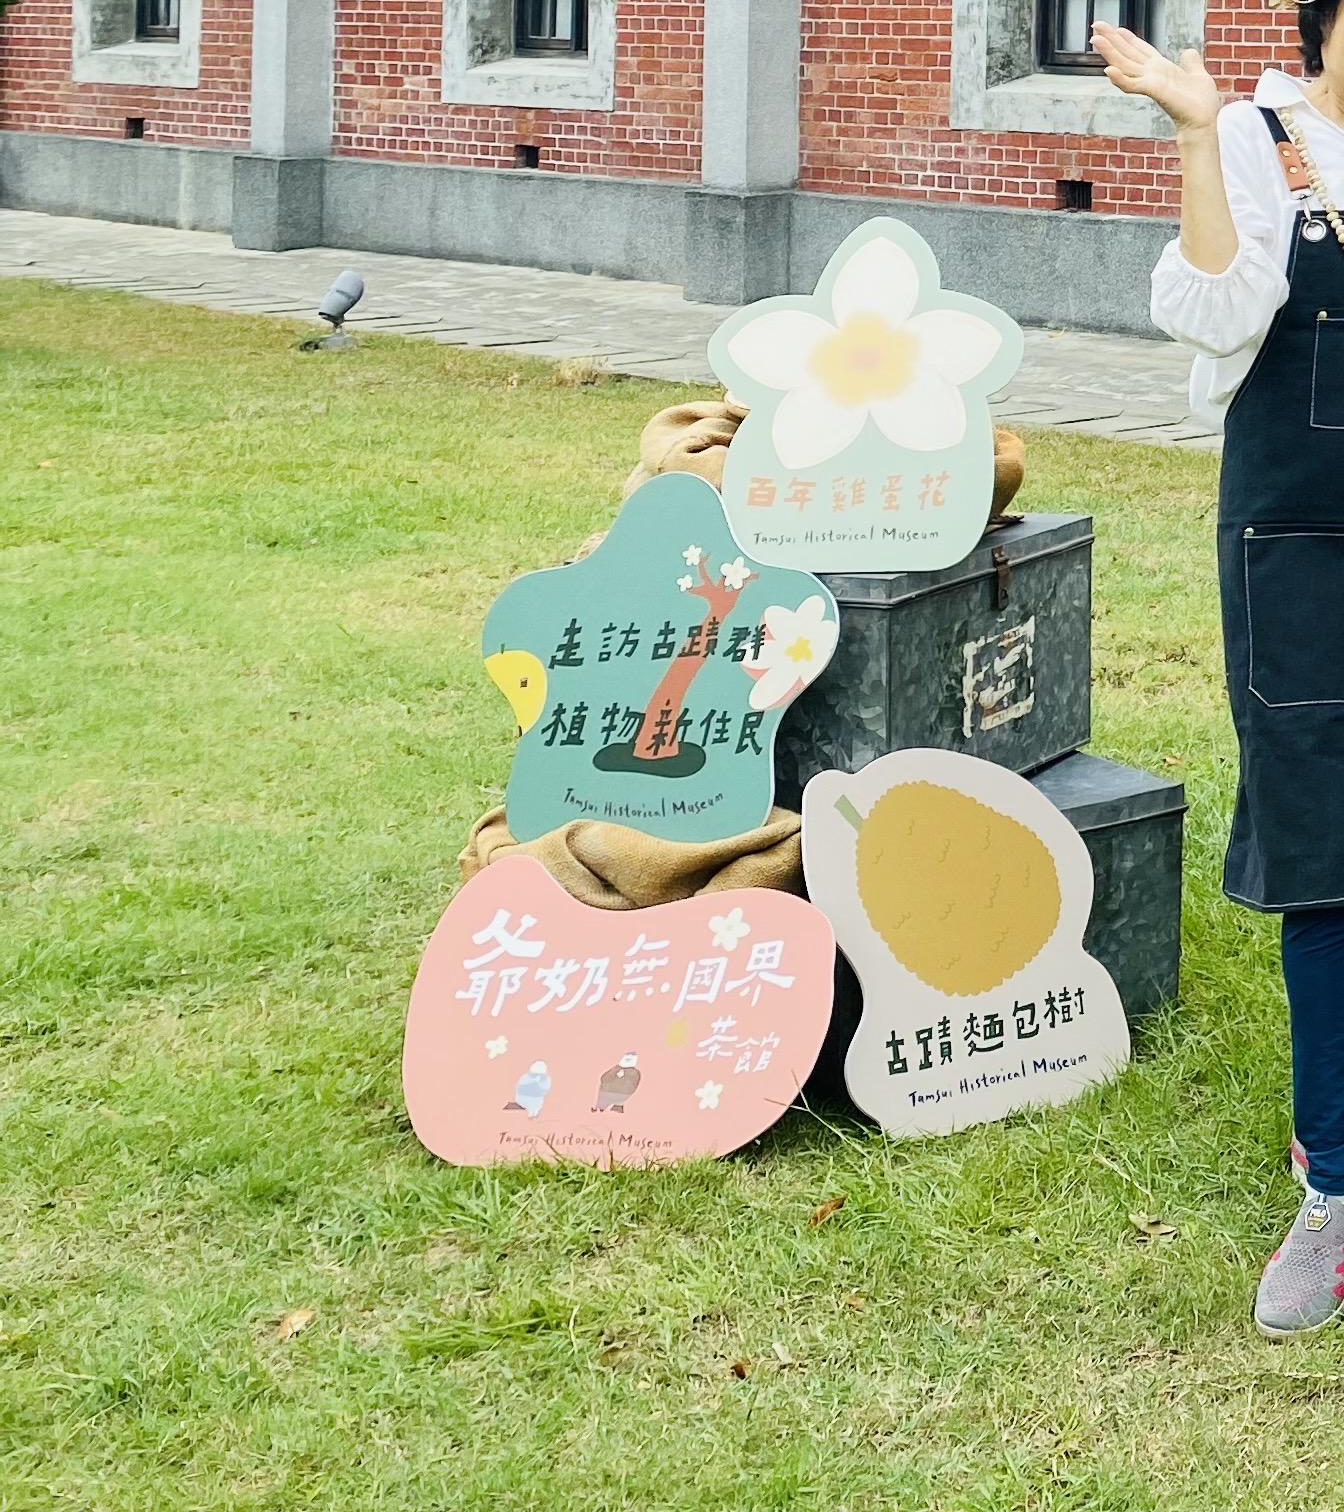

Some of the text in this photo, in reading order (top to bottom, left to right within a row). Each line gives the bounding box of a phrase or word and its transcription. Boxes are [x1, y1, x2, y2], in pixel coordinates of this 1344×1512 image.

[747, 471, 951, 513] 百年雞蛋花
[753, 525, 939, 546] Tamsui Historical Museum
[548, 617, 767, 670] 走訪古蹟群
[540, 698, 765, 757] 植物新住民
[564, 788, 724, 818] Tamsui Historical Museum
[455, 909, 796, 1017] 爺奶無國界
[696, 1015, 780, 1073] 茶館
[885, 986, 1085, 1076] 古蹟麵包樹
[908, 1054, 1088, 1107] Tamsui Historical Museum
[499, 1131, 673, 1149] Tamsui Historical Museum
